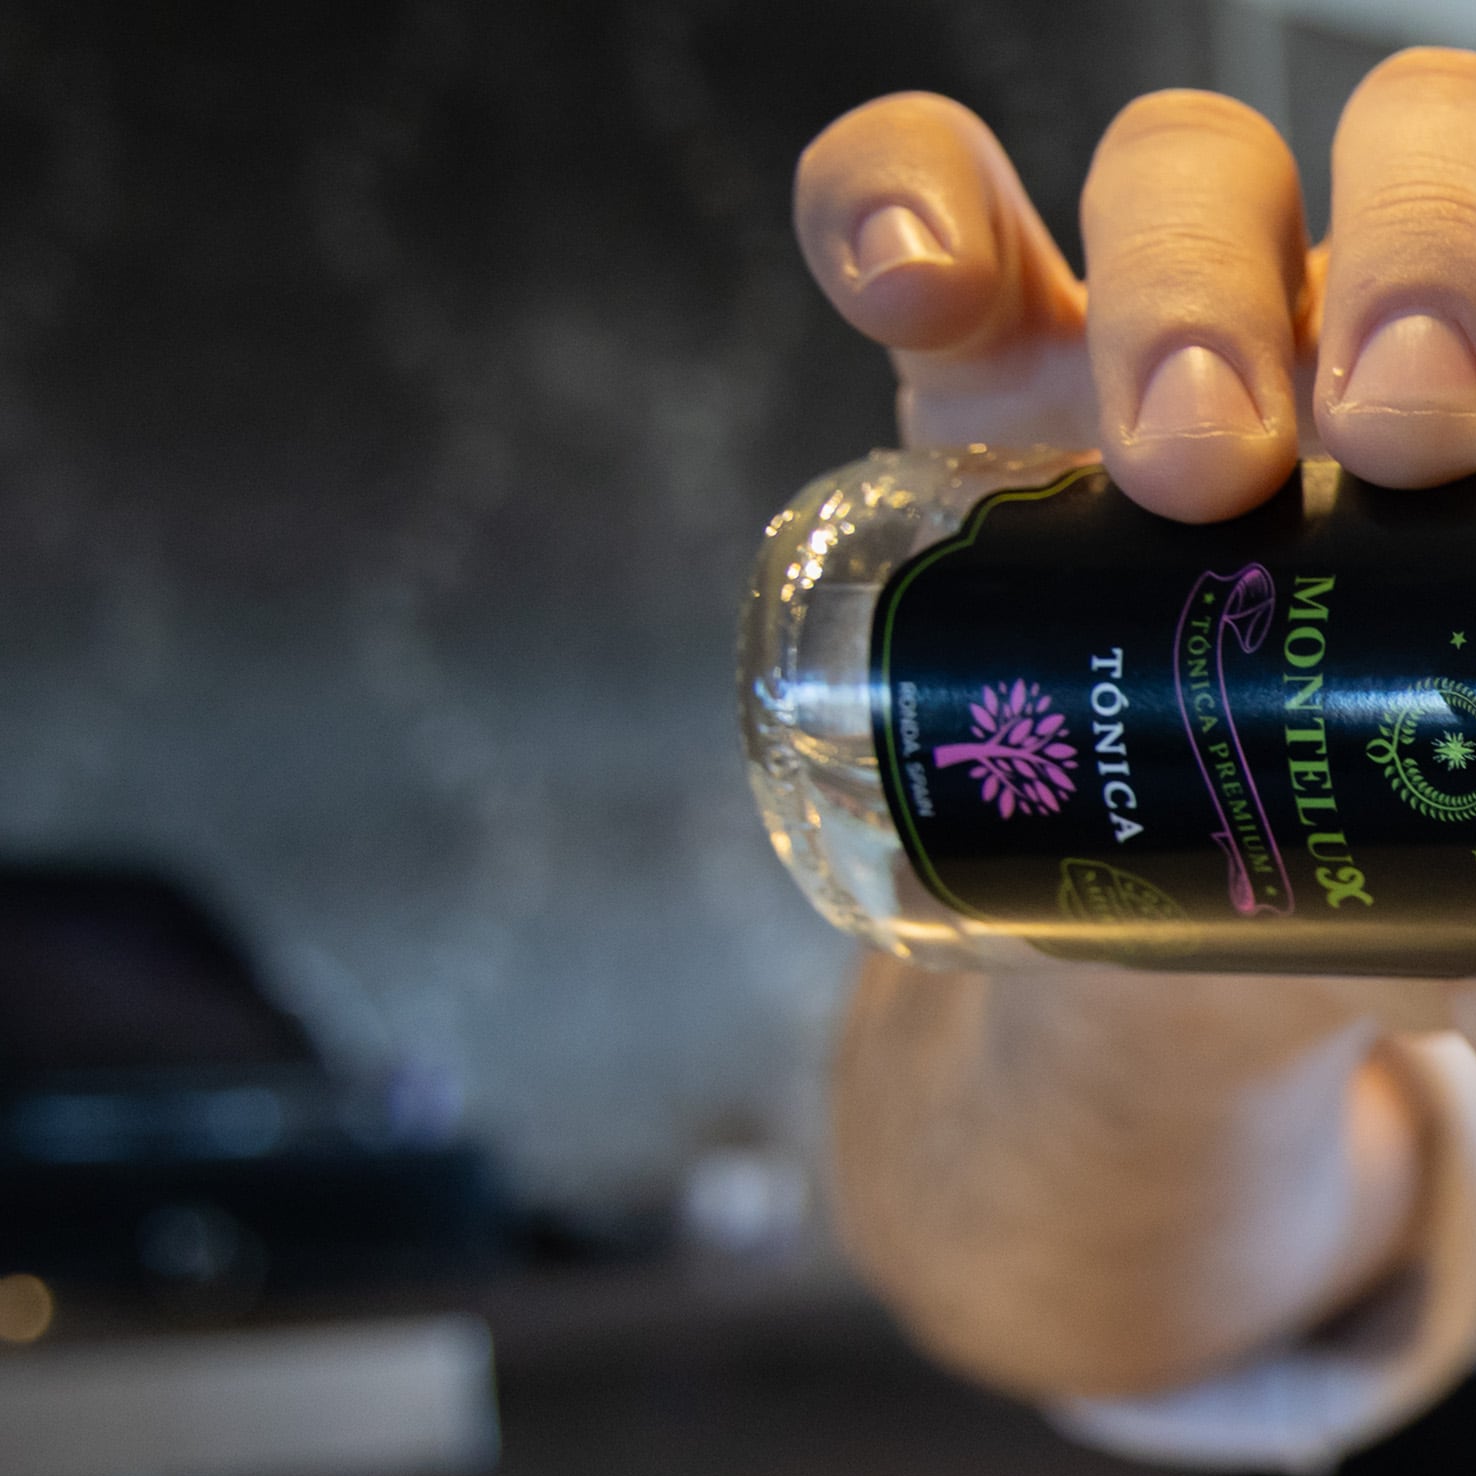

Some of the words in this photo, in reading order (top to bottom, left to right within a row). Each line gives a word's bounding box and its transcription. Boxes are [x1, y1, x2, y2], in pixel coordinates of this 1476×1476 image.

[1090, 647, 1145, 843] TÓNICA
[1187, 615, 1219, 734] TÓNICA
[1208, 741, 1274, 874] PREMIUM
[1283, 574, 1374, 909] MONTELUX
